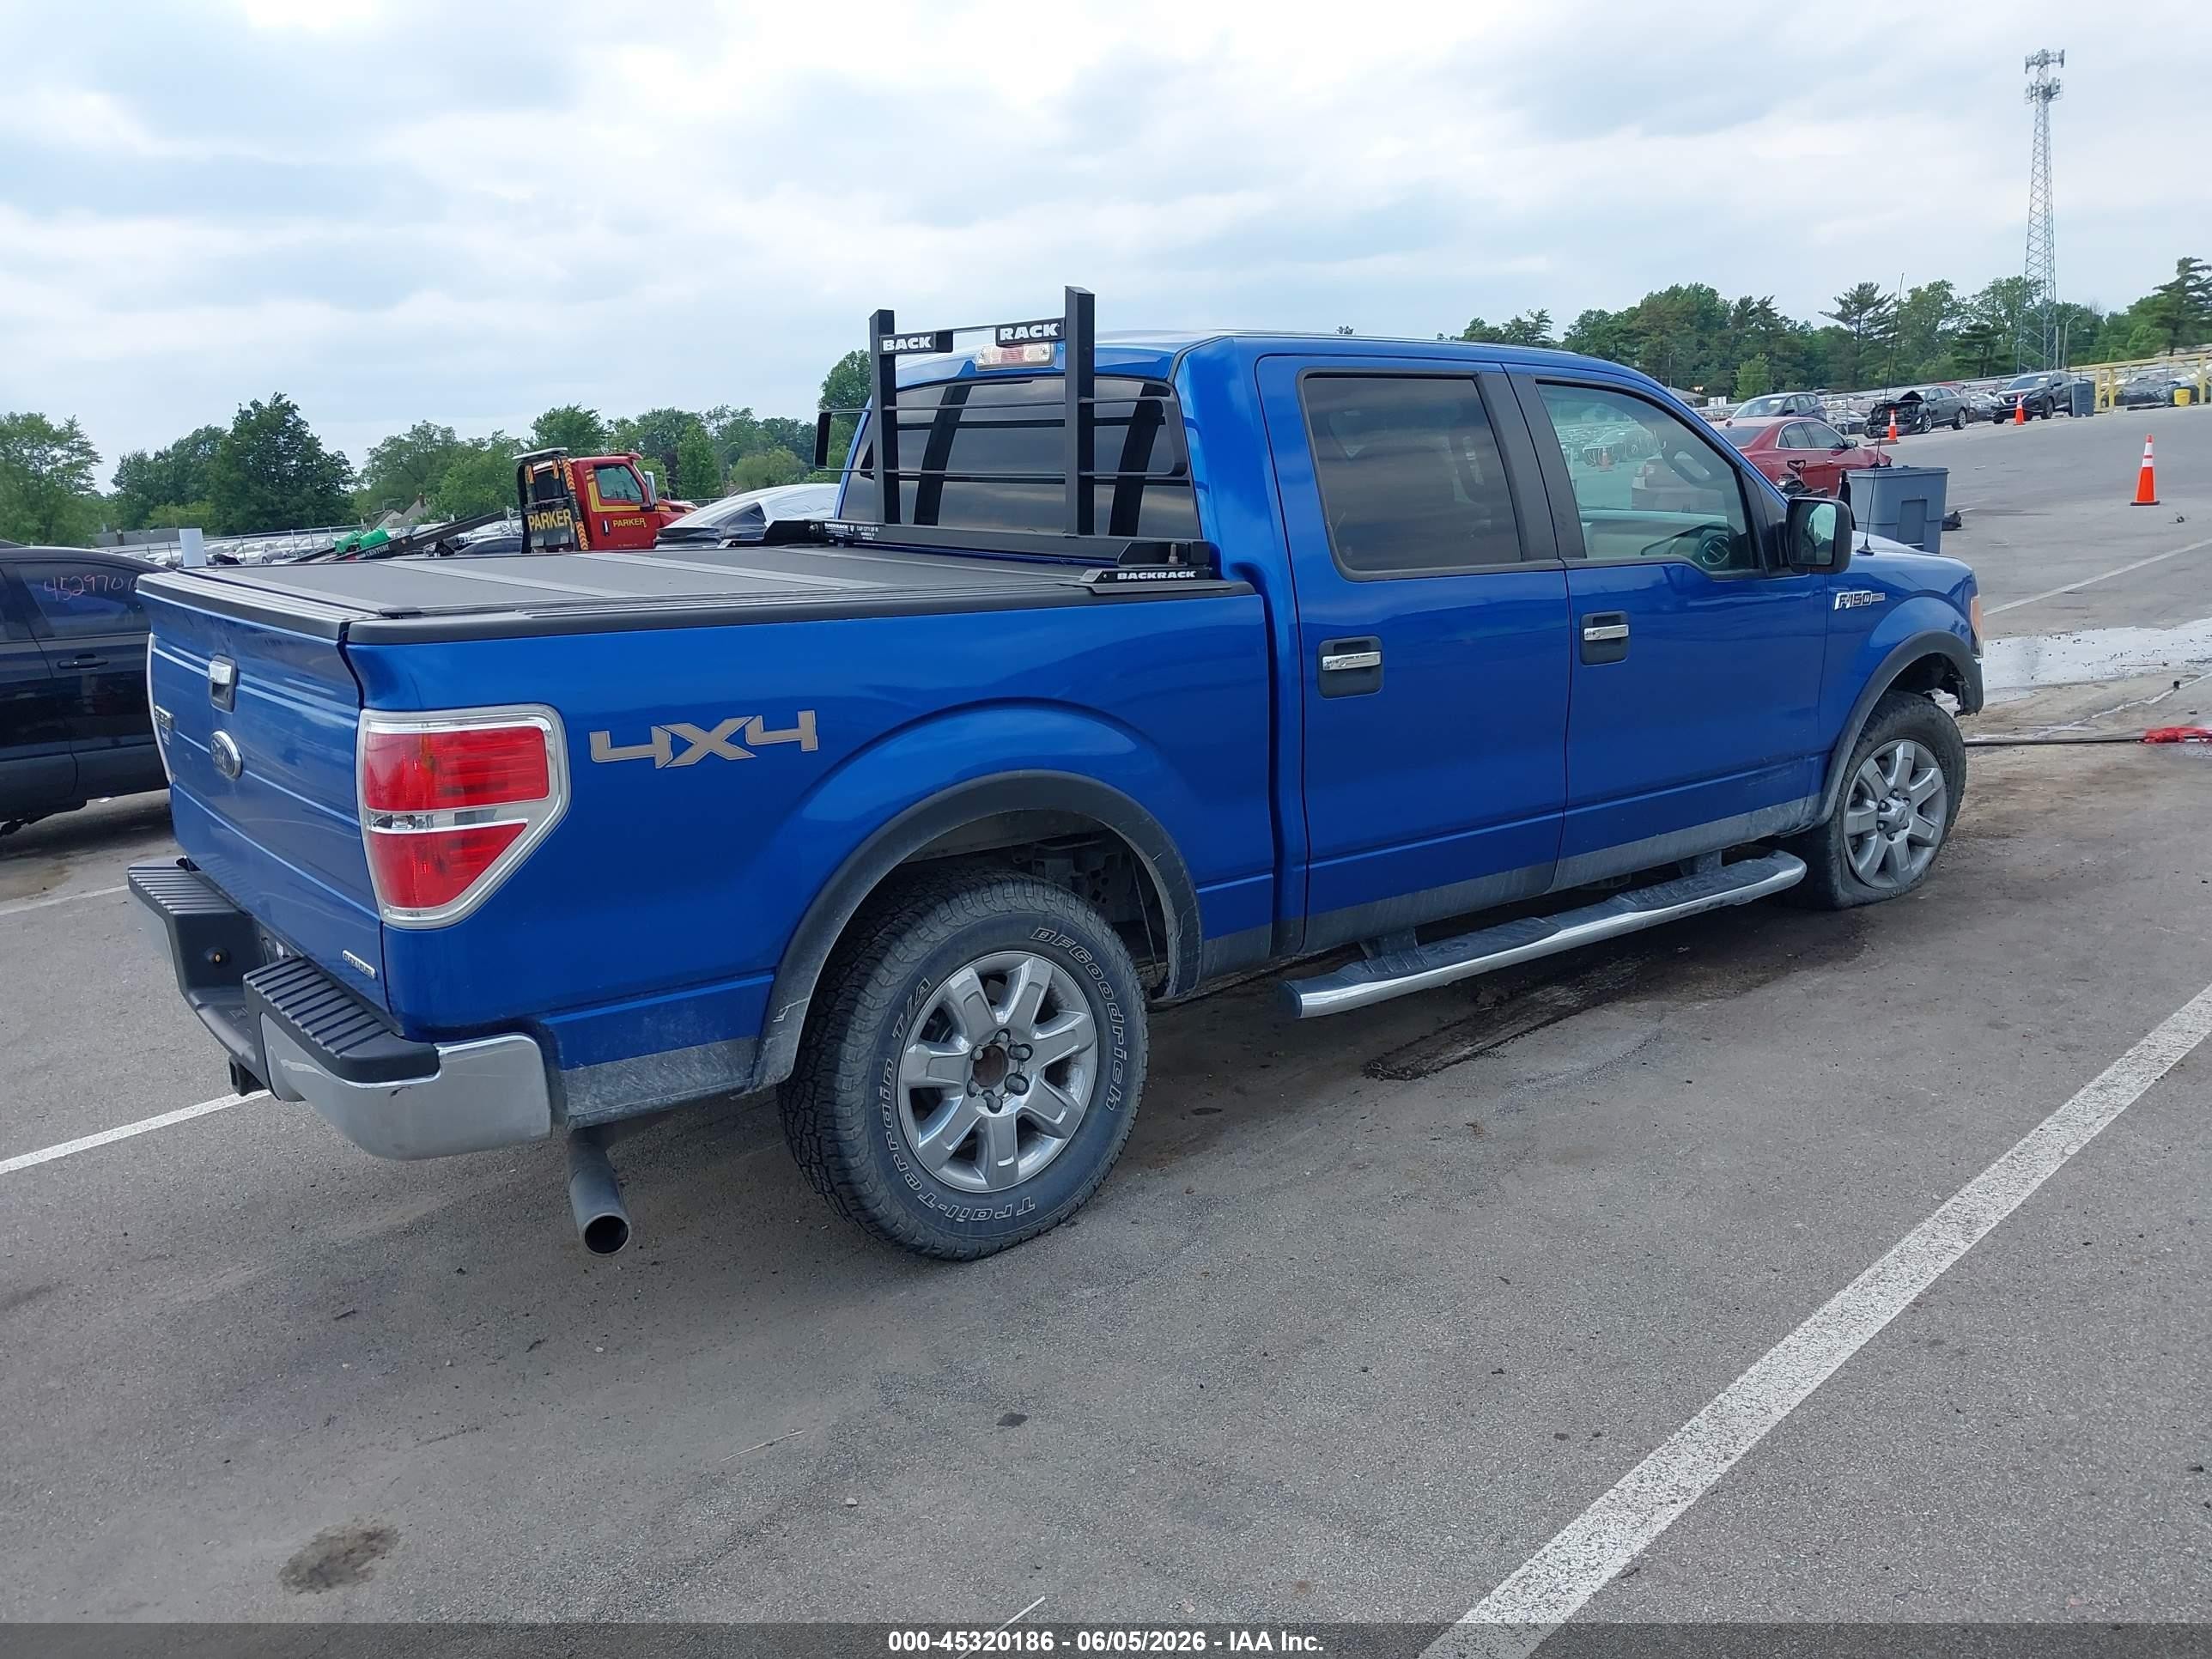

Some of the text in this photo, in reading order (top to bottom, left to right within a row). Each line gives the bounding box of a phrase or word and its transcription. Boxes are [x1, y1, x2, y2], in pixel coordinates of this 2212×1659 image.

[883, 323, 1059, 352] BACK RACK
[527, 508, 575, 533] PARKER
[612, 518, 647, 528] PARKER
[365, 544, 390, 557] CENTURY
[1117, 570, 1196, 580] BACKRACK
[44, 574, 137, 602] 4529701
[1030, 927, 1128, 1111] BFGoodrich
